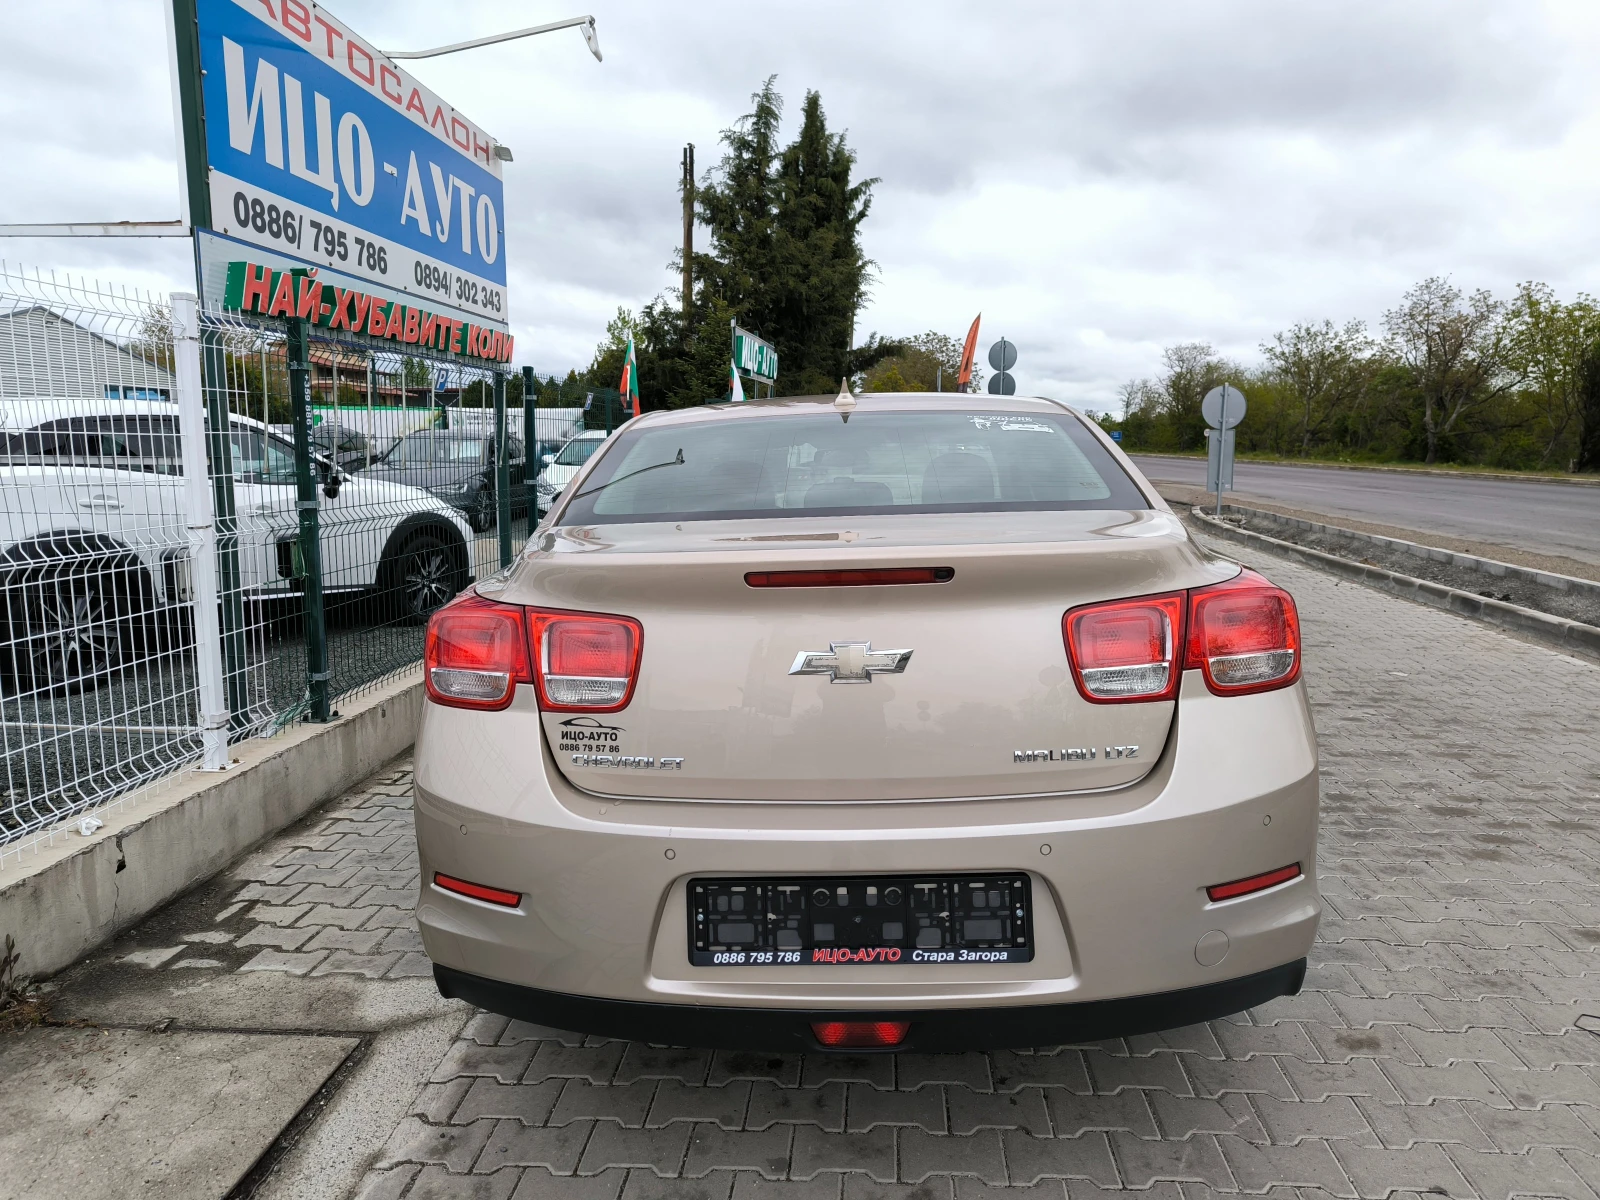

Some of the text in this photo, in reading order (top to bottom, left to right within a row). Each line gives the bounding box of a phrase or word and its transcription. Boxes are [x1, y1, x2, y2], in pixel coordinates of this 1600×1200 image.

[233, 191, 388, 275] 0886/ 795 786
[414, 260, 501, 313] 0894/ 302 343
[241, 262, 515, 364] НАЙ-ХУБАВИТЕ КОЛИ
[305, 405, 313, 425] 886
[307, 428, 315, 443] 79
[308, 446, 316, 459] 57
[309, 462, 316, 476] 86
[561, 730, 618, 742] ИЦО-АУТО
[559, 743, 620, 753] 0886 79 57 86
[1013, 745, 1139, 763] MALIBU LTZ
[571, 754, 685, 770] CHEVROLET
[713, 947, 1008, 964] 0886 795 786 ИЦО-АУТО Стара Загора
